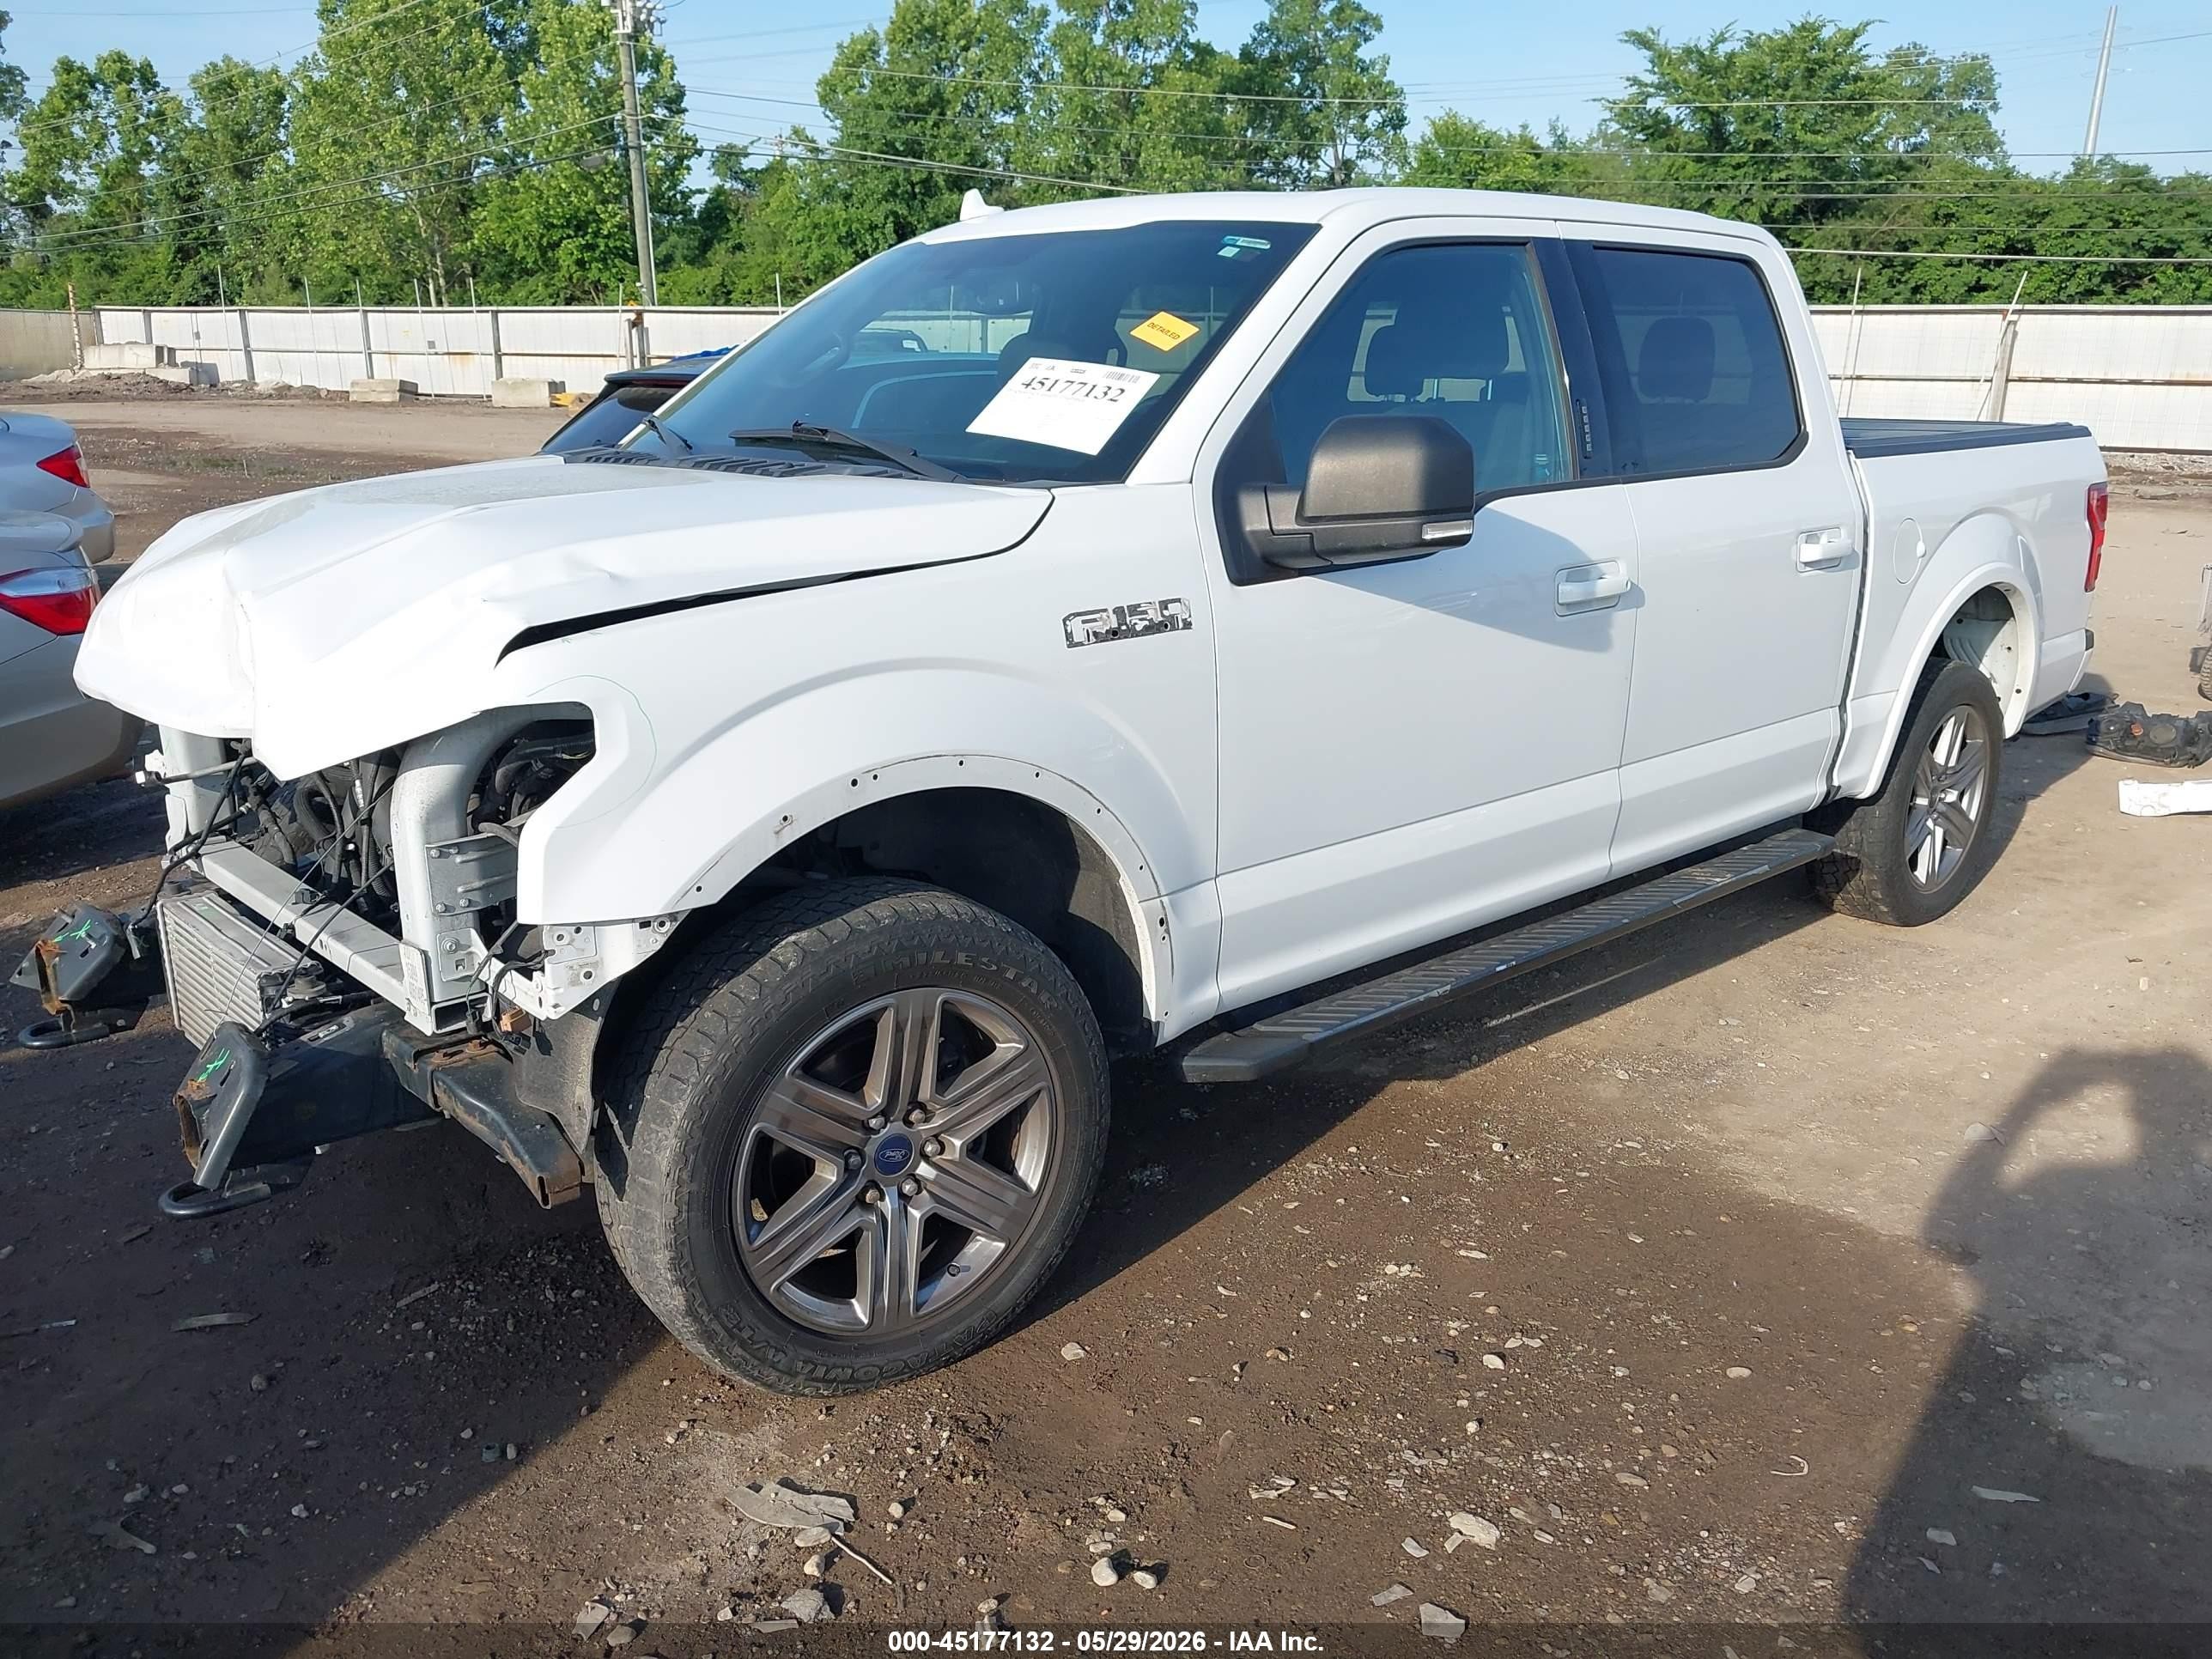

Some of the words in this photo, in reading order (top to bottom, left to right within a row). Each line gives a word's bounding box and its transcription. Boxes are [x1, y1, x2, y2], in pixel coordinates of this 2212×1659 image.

[1147, 322, 1181, 340] DETAILED
[1021, 376, 1126, 402] 45177132
[881, 949, 1061, 1011] MILESTAR
